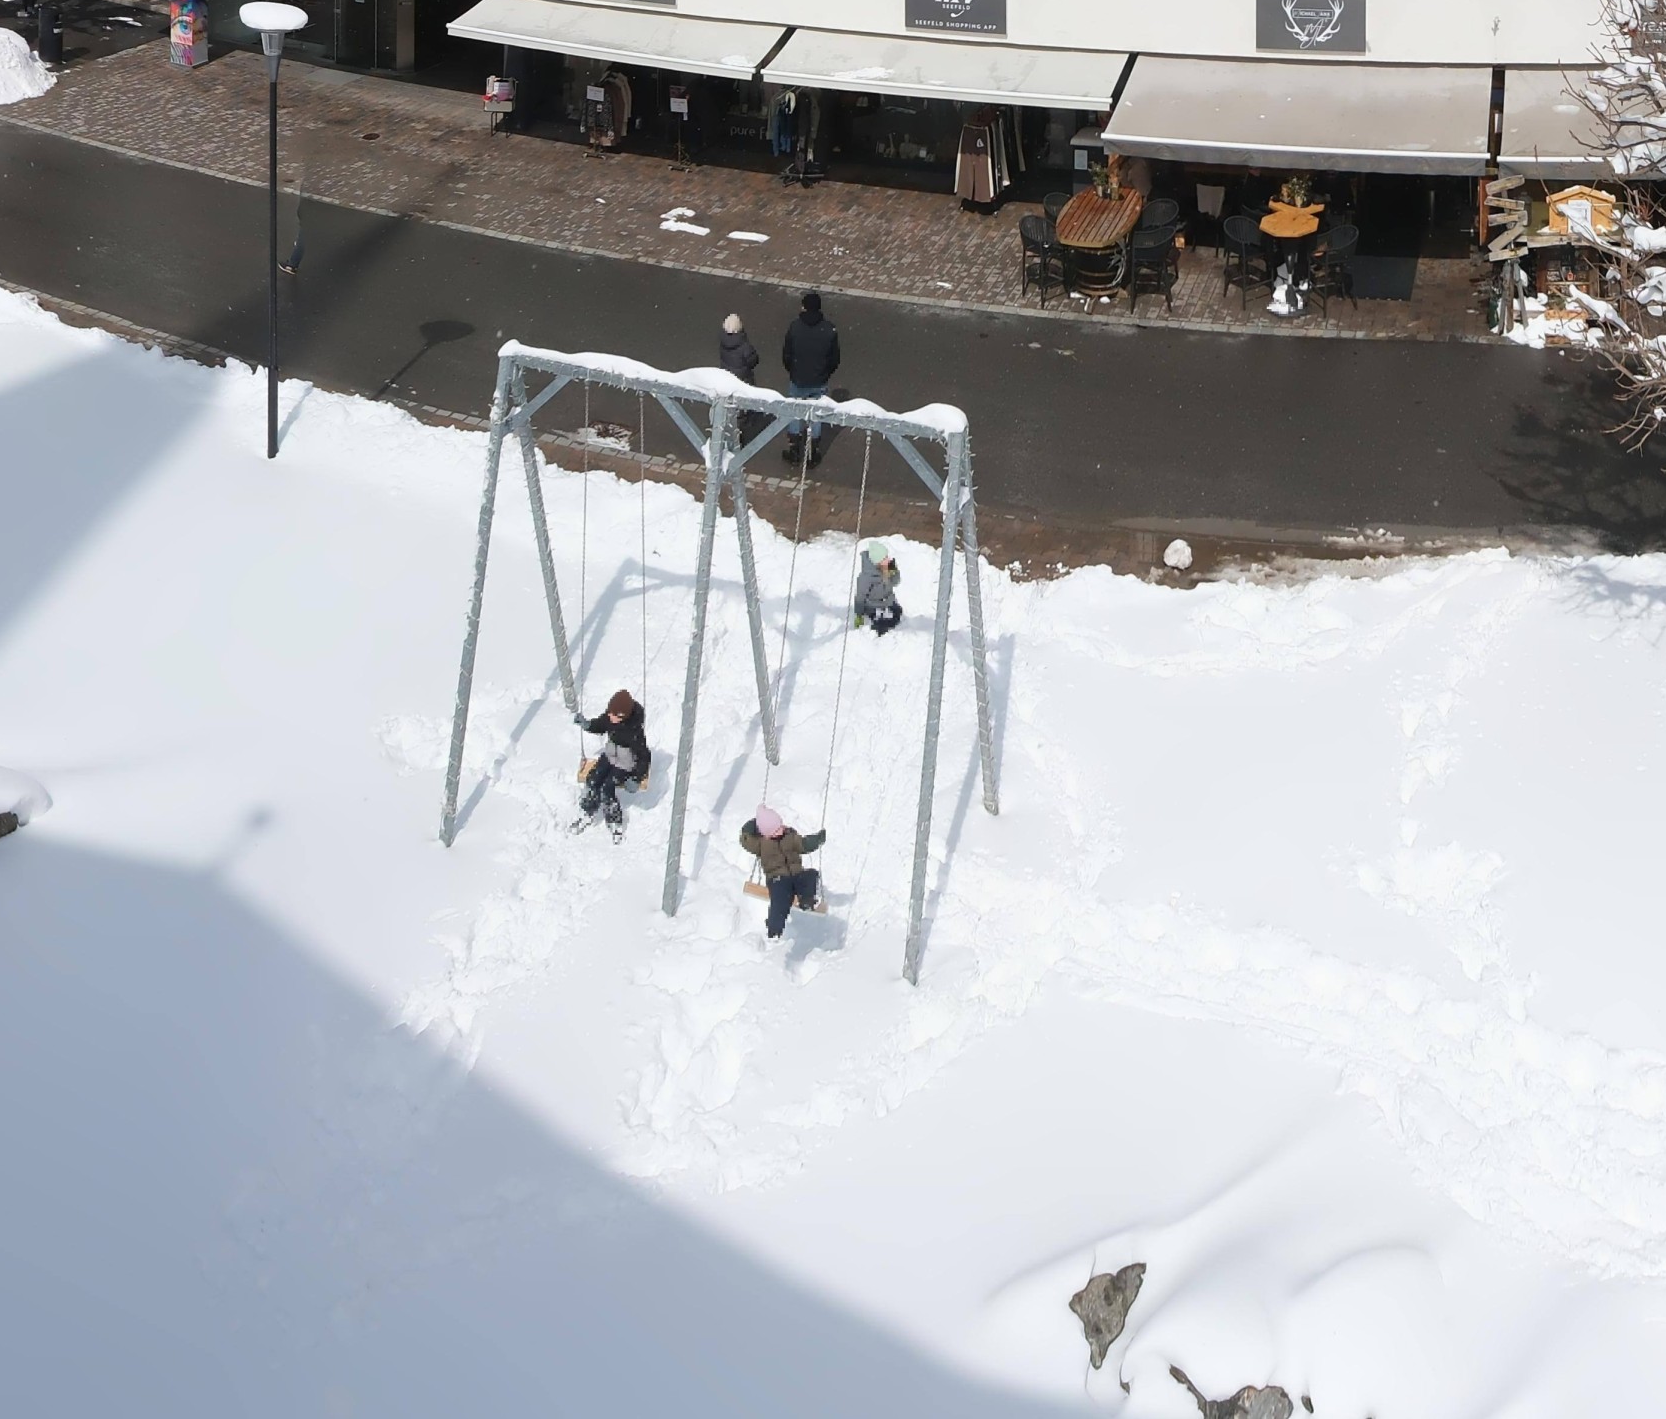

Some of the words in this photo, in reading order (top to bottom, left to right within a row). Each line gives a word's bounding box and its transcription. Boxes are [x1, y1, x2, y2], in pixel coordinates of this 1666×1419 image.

[942, 3, 971, 11] SEEFELD
[915, 19, 944, 27] SEEFELD
[946, 21, 981, 30] SHOPPING
